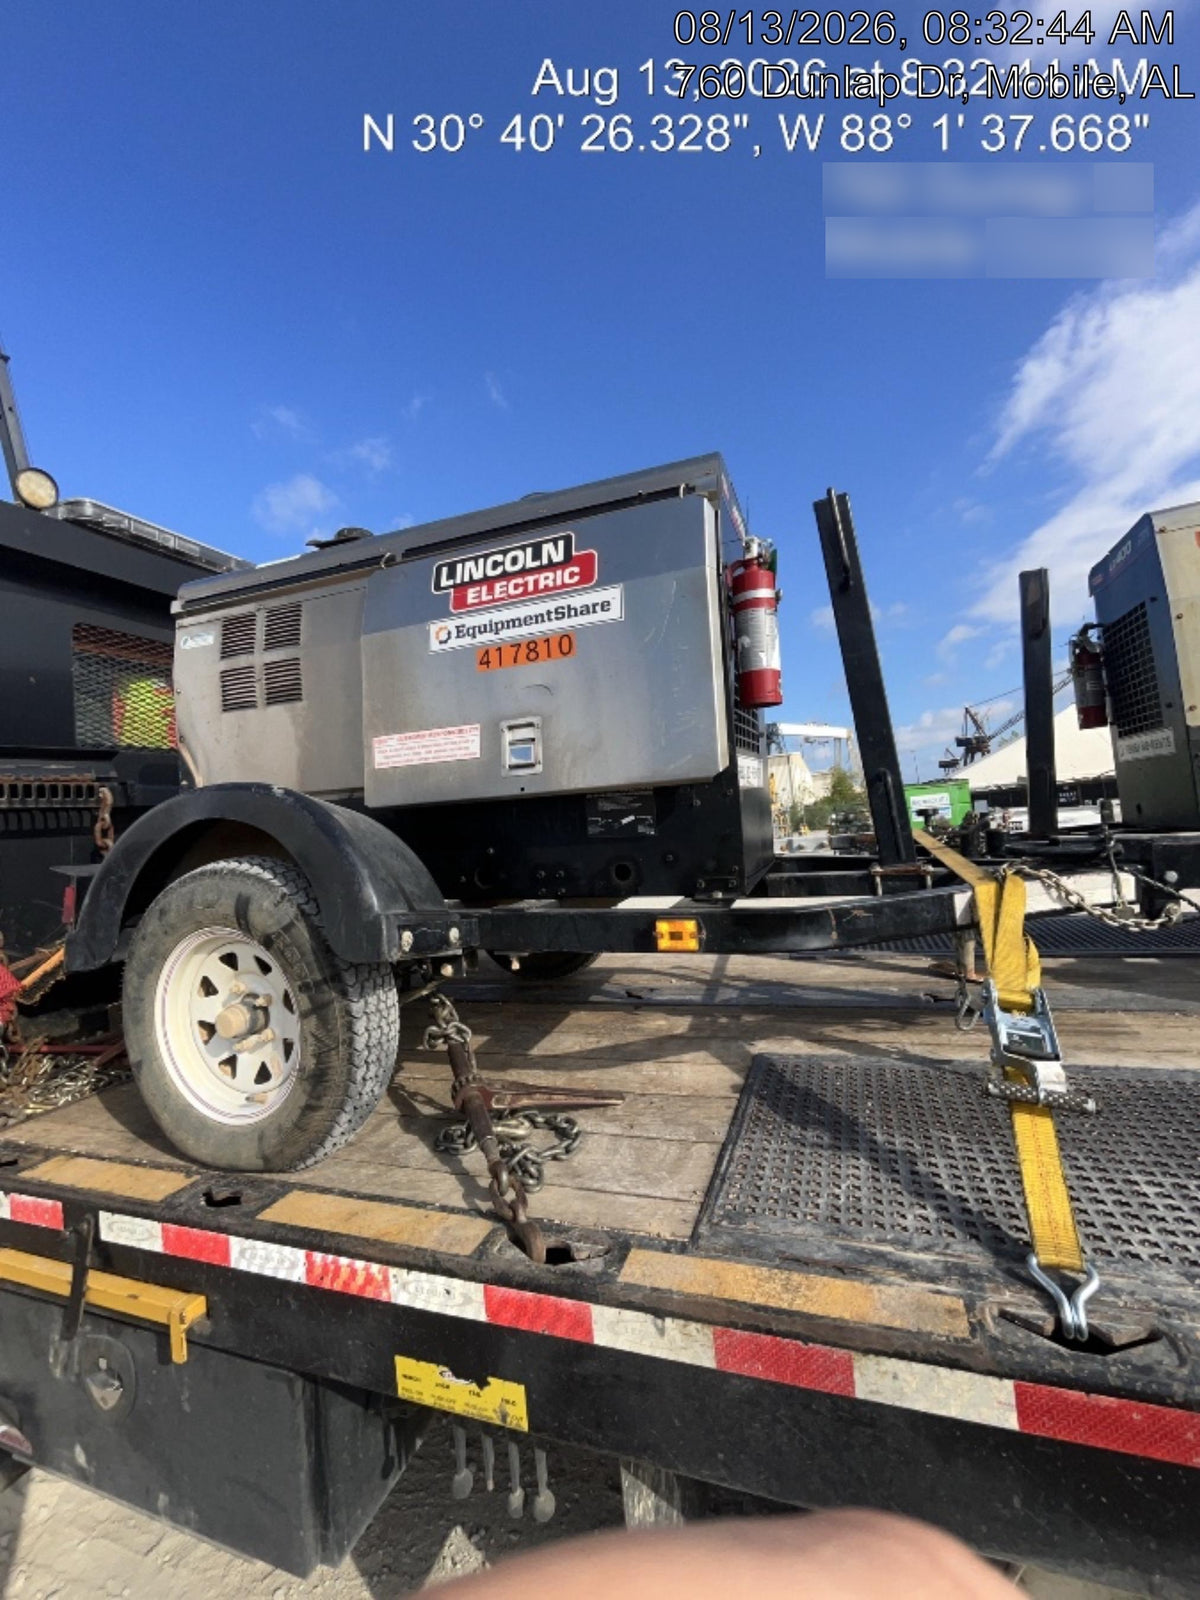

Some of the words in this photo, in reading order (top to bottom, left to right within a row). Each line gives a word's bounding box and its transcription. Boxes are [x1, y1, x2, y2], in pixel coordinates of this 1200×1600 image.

[440, 539, 564, 588] LINCOLN
[466, 566, 581, 606] ELECTRIC
[455, 600, 611, 641] EquipmentShare
[479, 634, 574, 669] 417810
